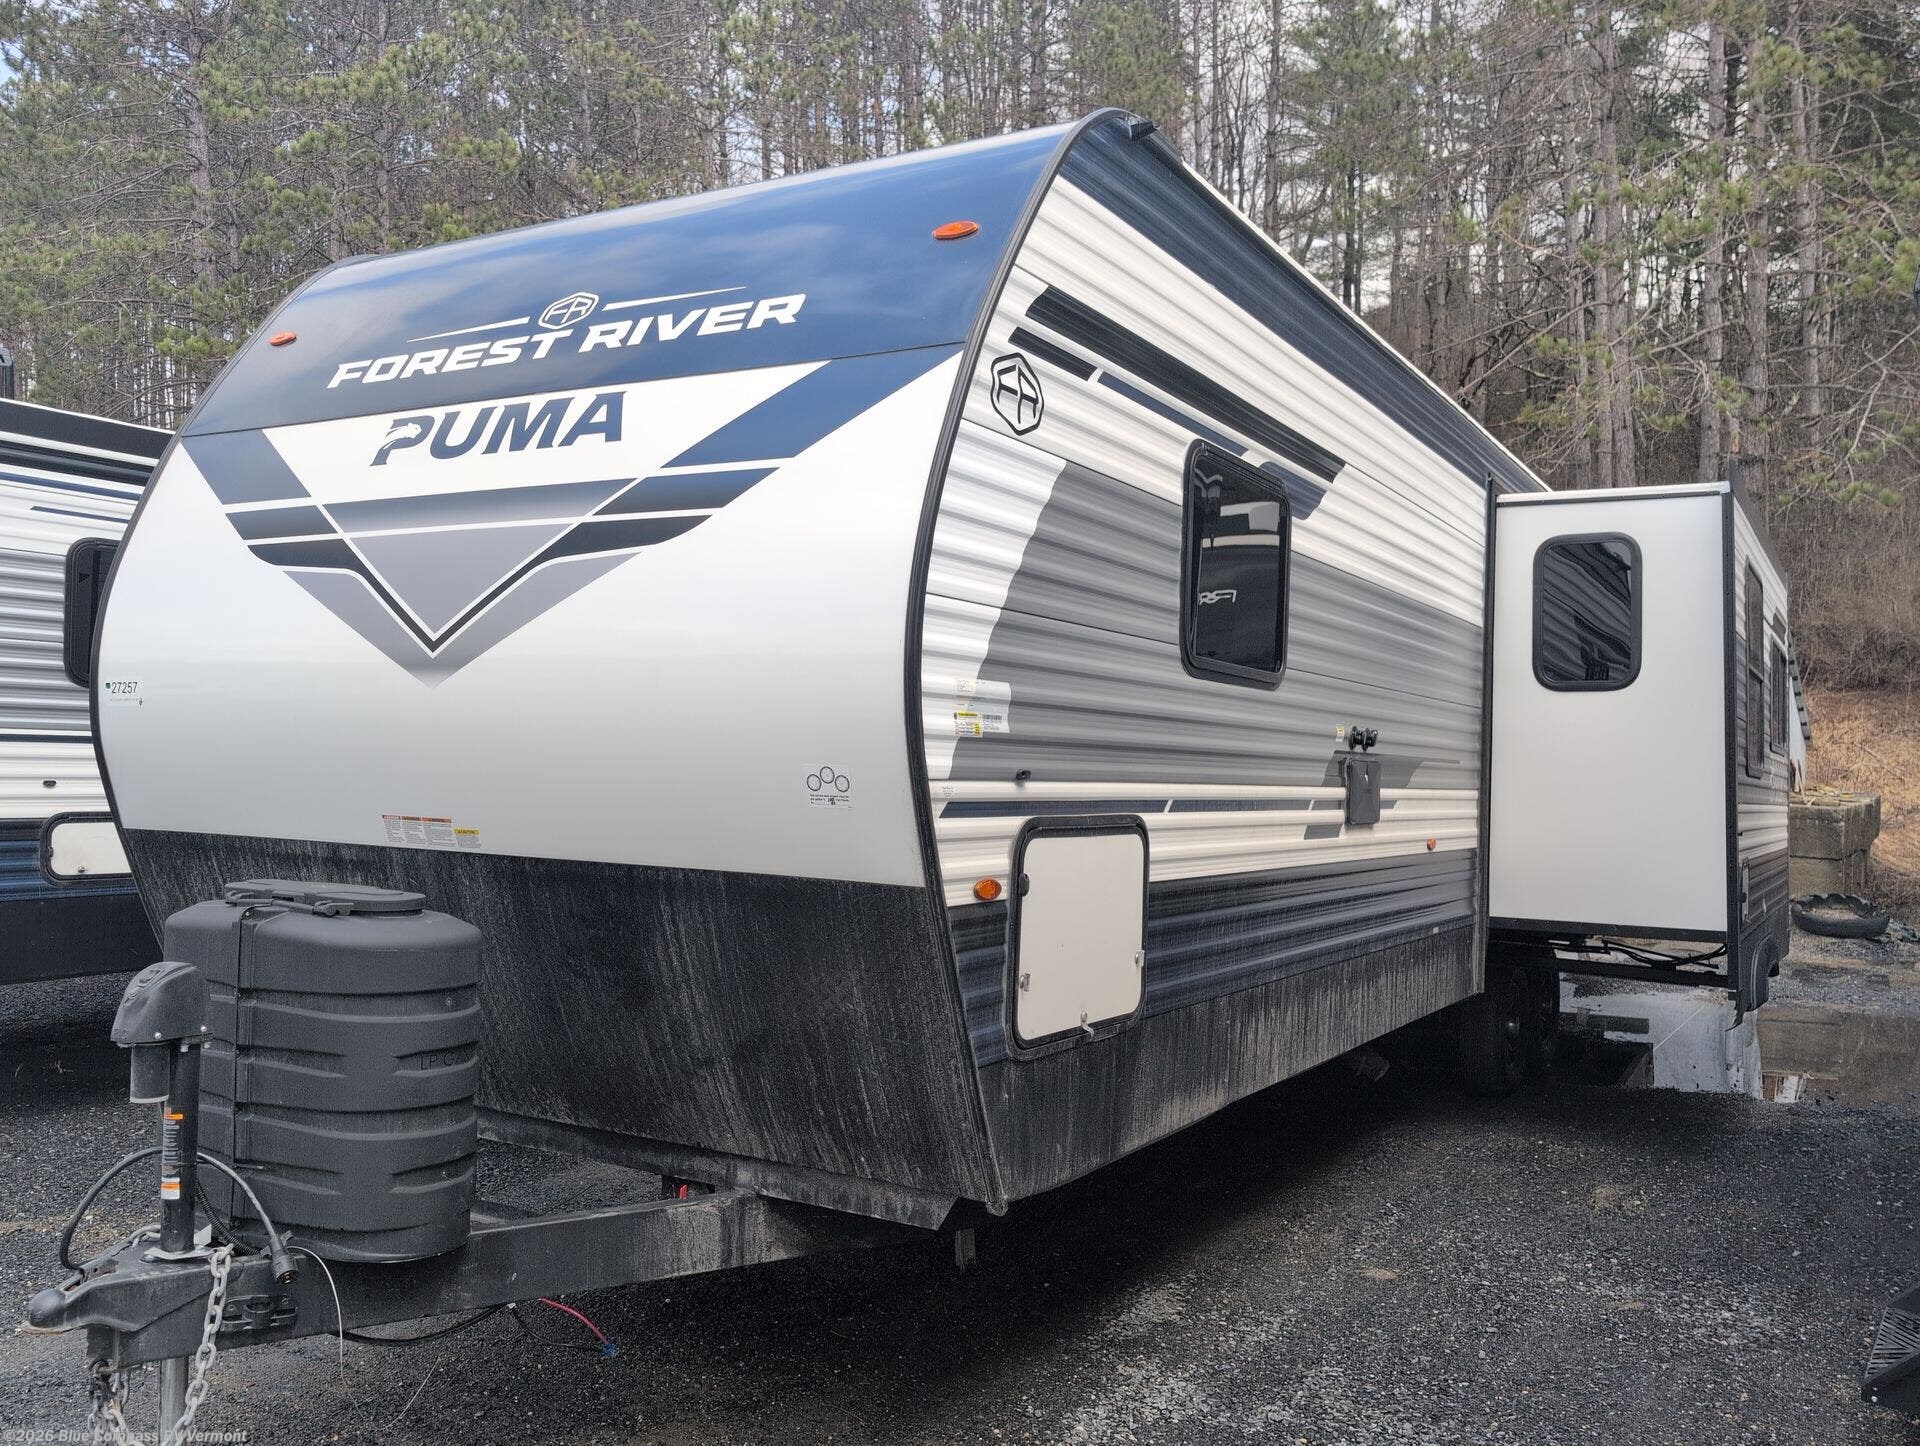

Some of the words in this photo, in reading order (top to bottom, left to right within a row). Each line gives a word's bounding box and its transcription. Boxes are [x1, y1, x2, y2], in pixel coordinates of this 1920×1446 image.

[326, 328, 574, 390] FOREST
[579, 292, 807, 354] RIVER
[369, 390, 628, 467] PUMA
[111, 681, 138, 694] 27257
